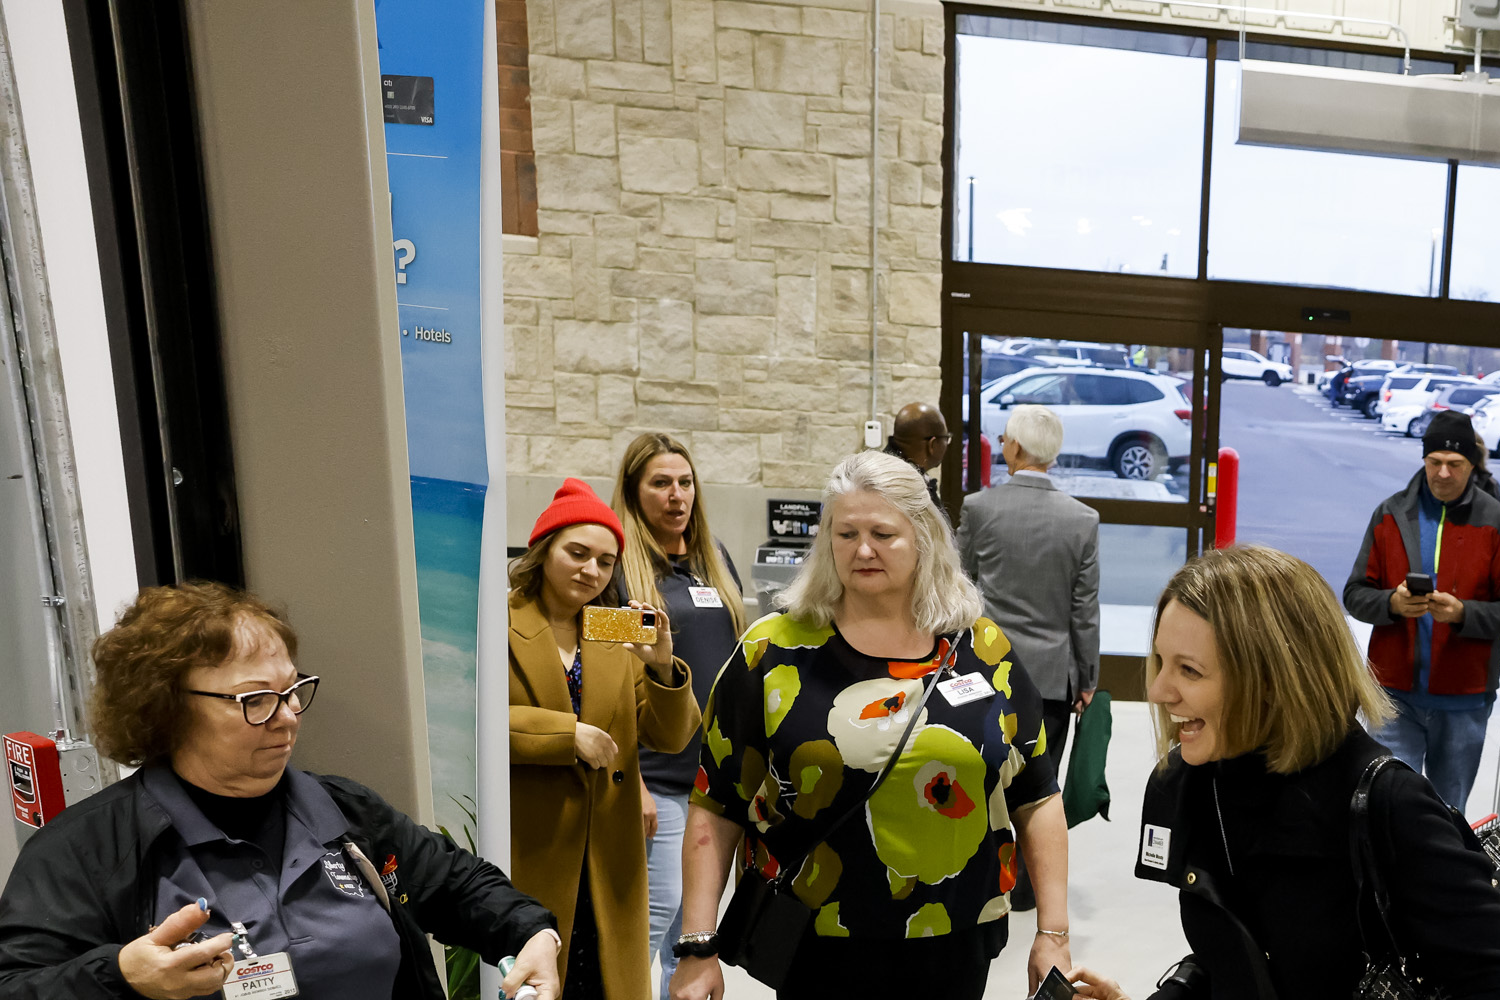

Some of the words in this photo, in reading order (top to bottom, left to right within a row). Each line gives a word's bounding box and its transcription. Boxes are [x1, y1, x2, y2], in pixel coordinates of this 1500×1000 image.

[415, 326, 452, 343] Hotels
[950, 678, 973, 688] COSTCO
[957, 687, 974, 695] LISA
[6, 740, 31, 764] FIRE
[237, 963, 274, 976] COSTCO
[242, 976, 275, 991] PATTY
